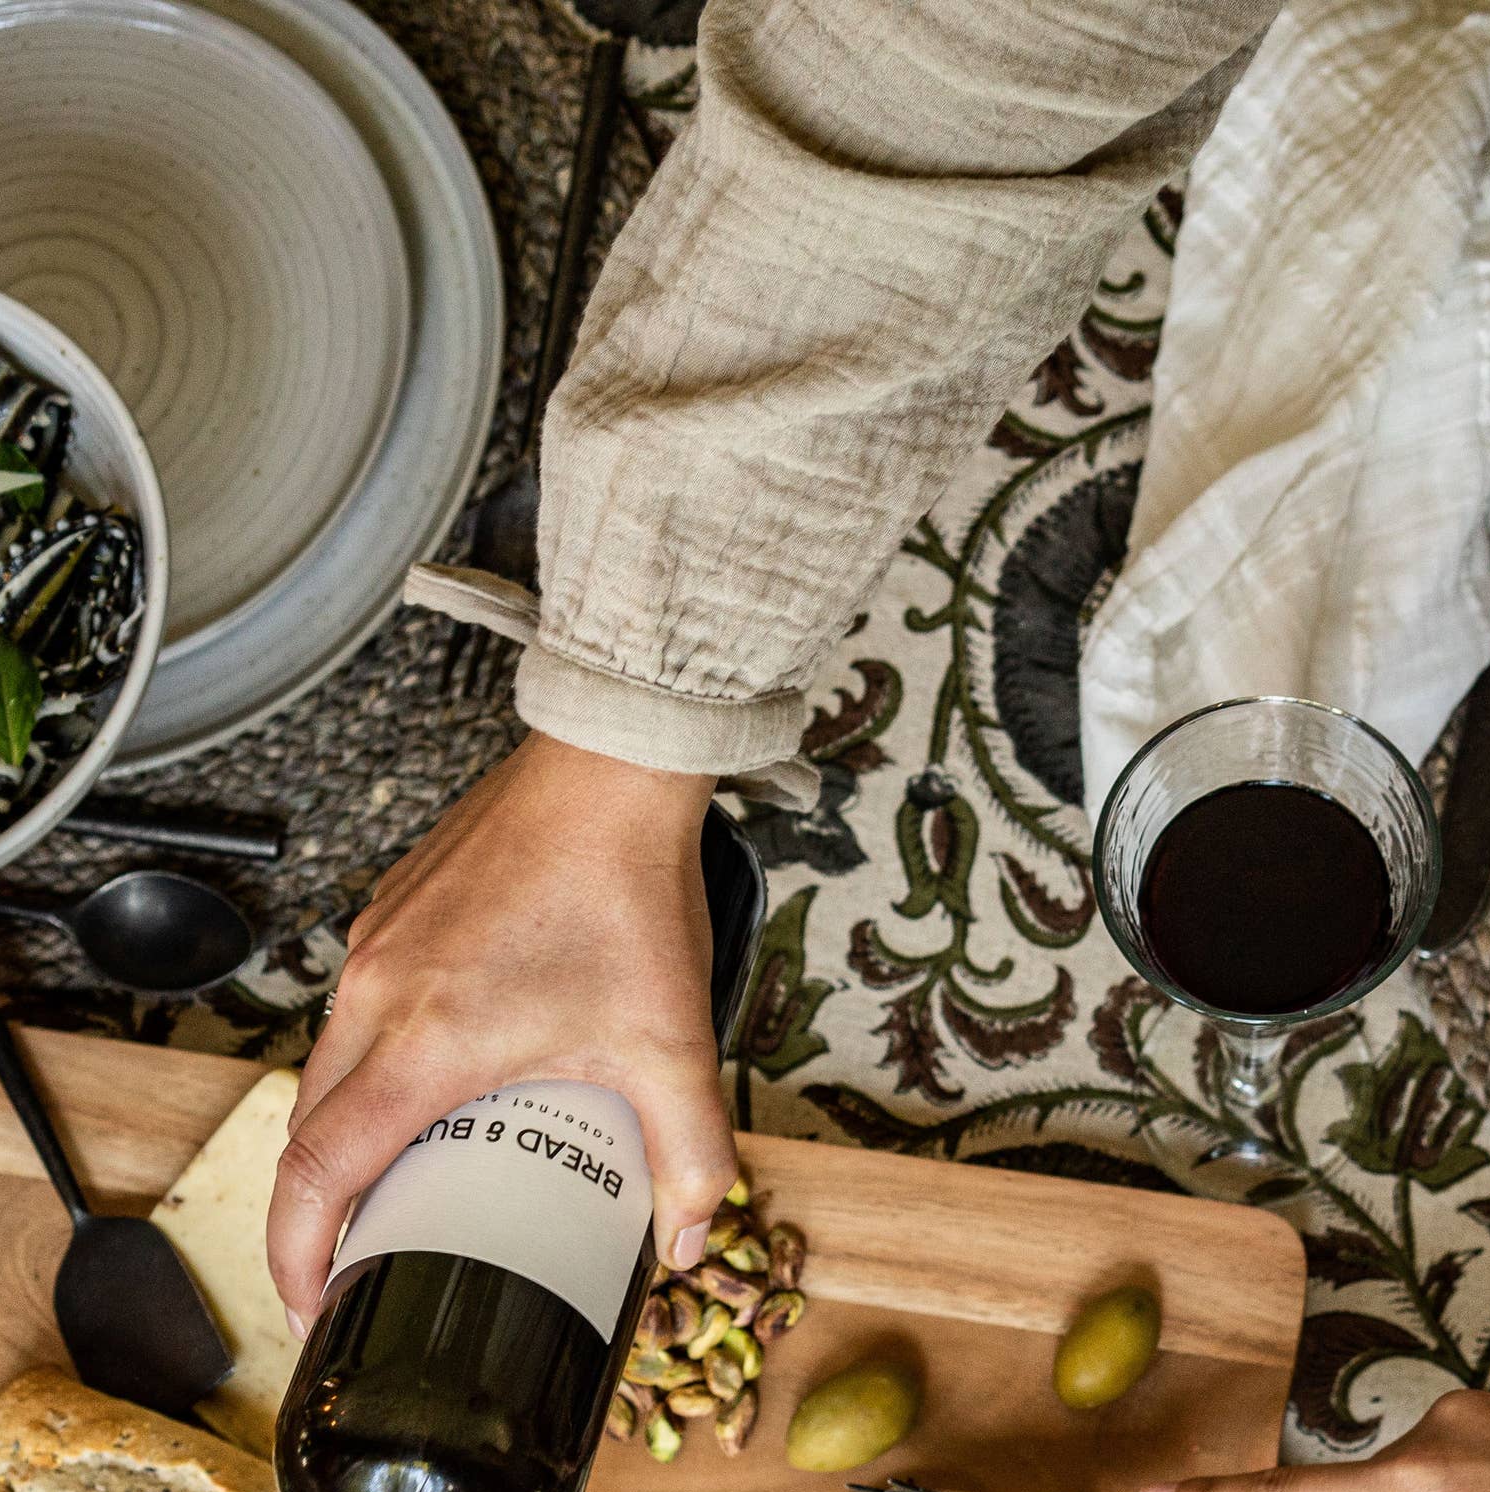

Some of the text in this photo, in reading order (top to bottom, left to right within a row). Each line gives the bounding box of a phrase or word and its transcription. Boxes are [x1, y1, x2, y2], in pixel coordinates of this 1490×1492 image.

[485, 1121, 505, 1142] &
[512, 1097, 614, 1146] cabernet
[516, 1128, 624, 1199] BREAD
